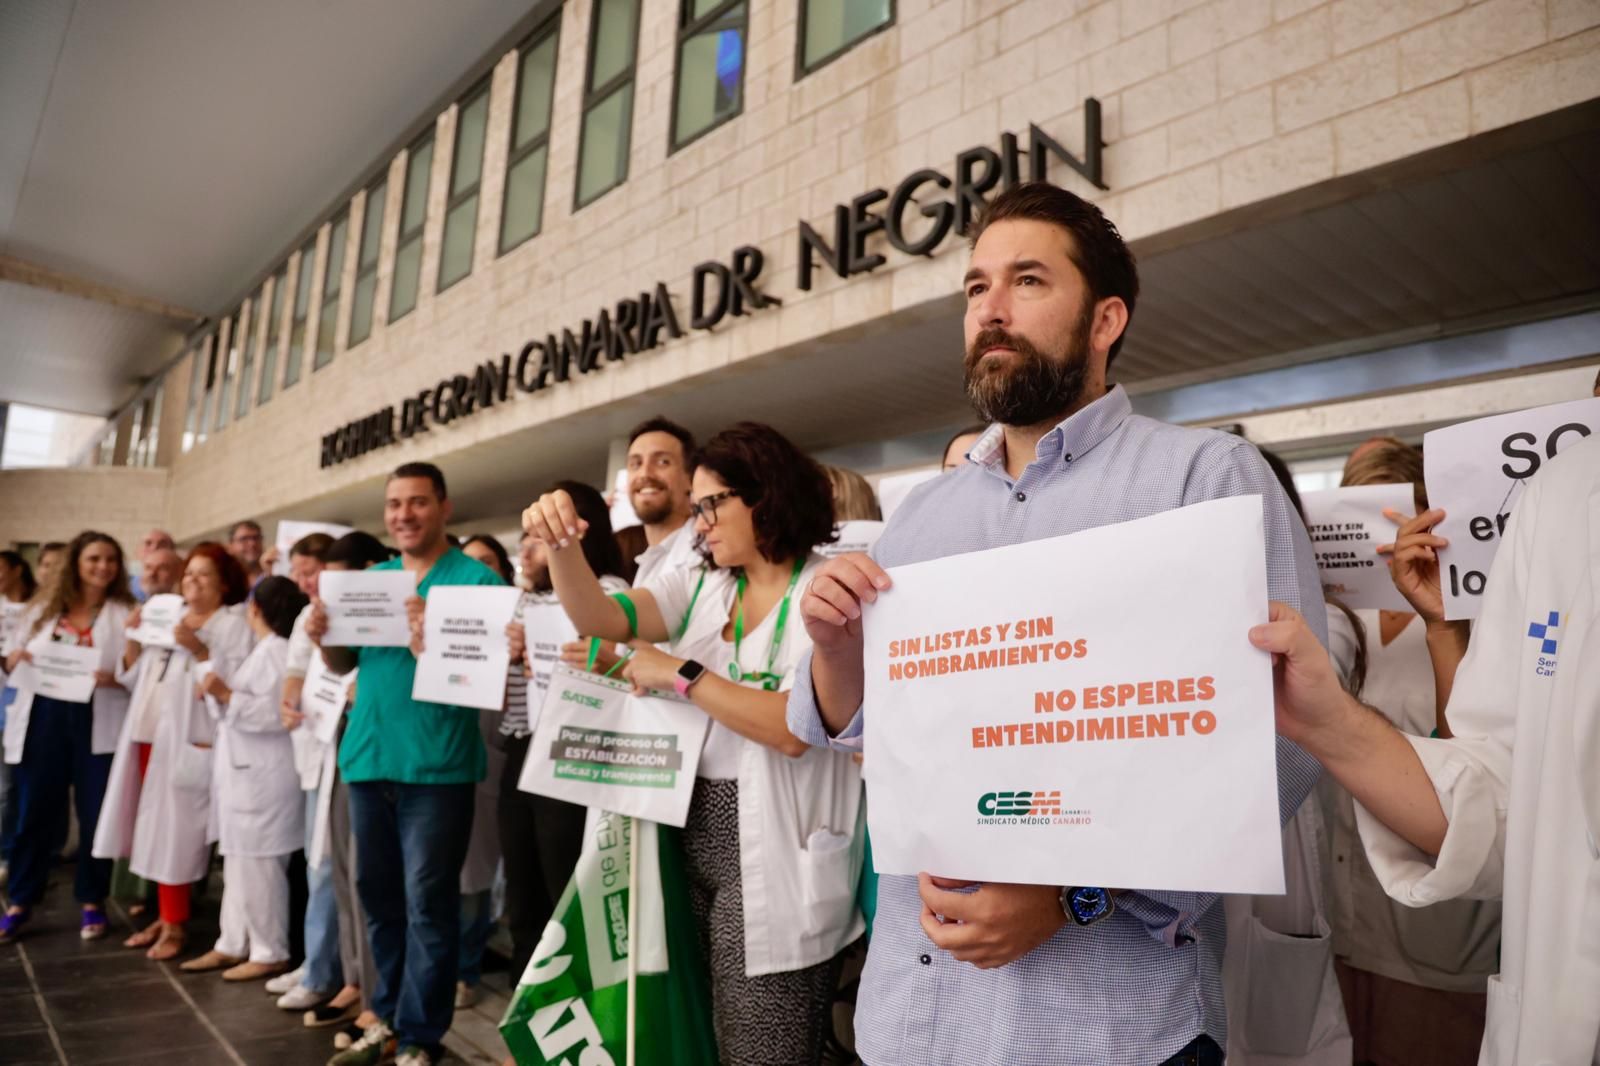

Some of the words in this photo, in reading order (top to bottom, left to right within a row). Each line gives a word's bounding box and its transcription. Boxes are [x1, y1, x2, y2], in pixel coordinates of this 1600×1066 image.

[432, 354, 511, 425] GRAN
[515, 281, 688, 393] CANARIA
[690, 245, 783, 330] DR.
[797, 97, 1110, 292] NEGRIN
[1322, 552, 1356, 560] QUEDA
[888, 637, 921, 658] SIN
[924, 626, 992, 653] LISTAS
[996, 623, 1012, 642] Y
[1014, 616, 1053, 640] SIN
[888, 638, 1088, 681] NOMBRAMIENTOS
[560, 689, 604, 710] SATSE
[1034, 689, 1077, 713] NO
[1082, 675, 1216, 710] ESPERES
[561, 729, 583, 742] Por
[584, 732, 601, 743] un
[603, 735, 652, 748] proceso
[653, 736, 670, 748] de
[971, 709, 1217, 748] ENTENDIMIENTO
[564, 745, 667, 766] ESTABILIZACIÓN
[557, 763, 591, 777] eficaz
[592, 768, 600, 779] y
[601, 769, 672, 783] transparente
[977, 790, 1061, 816] CESM
[977, 817, 1017, 825] SINDICATO
[1020, 815, 1051, 825] MÉDICO
[1053, 817, 1091, 825] CANARIO
